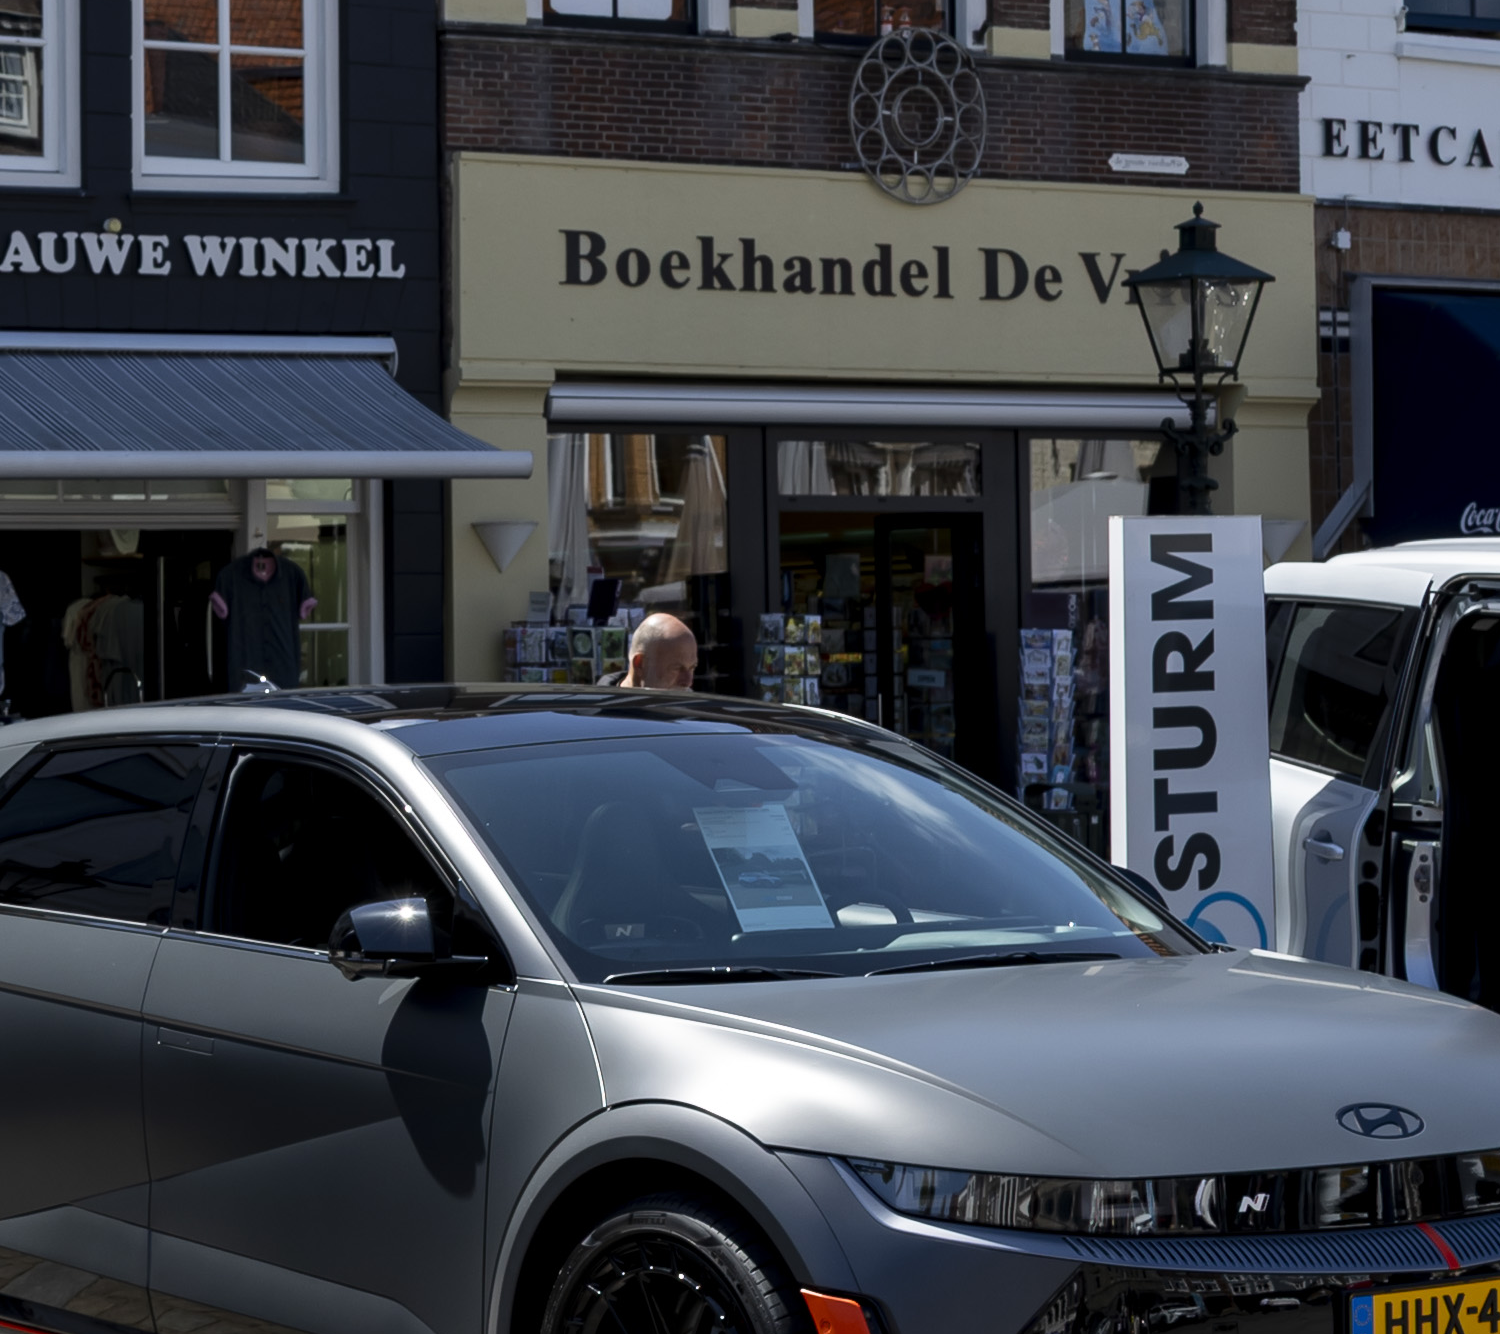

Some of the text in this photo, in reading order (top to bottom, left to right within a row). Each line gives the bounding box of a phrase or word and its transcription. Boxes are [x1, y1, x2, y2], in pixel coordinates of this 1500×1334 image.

[184, 234, 406, 279] WINKEL
[558, 227, 955, 301] Boekhandel
[977, 246, 1063, 302] De
[1149, 532, 1221, 892] STURM
